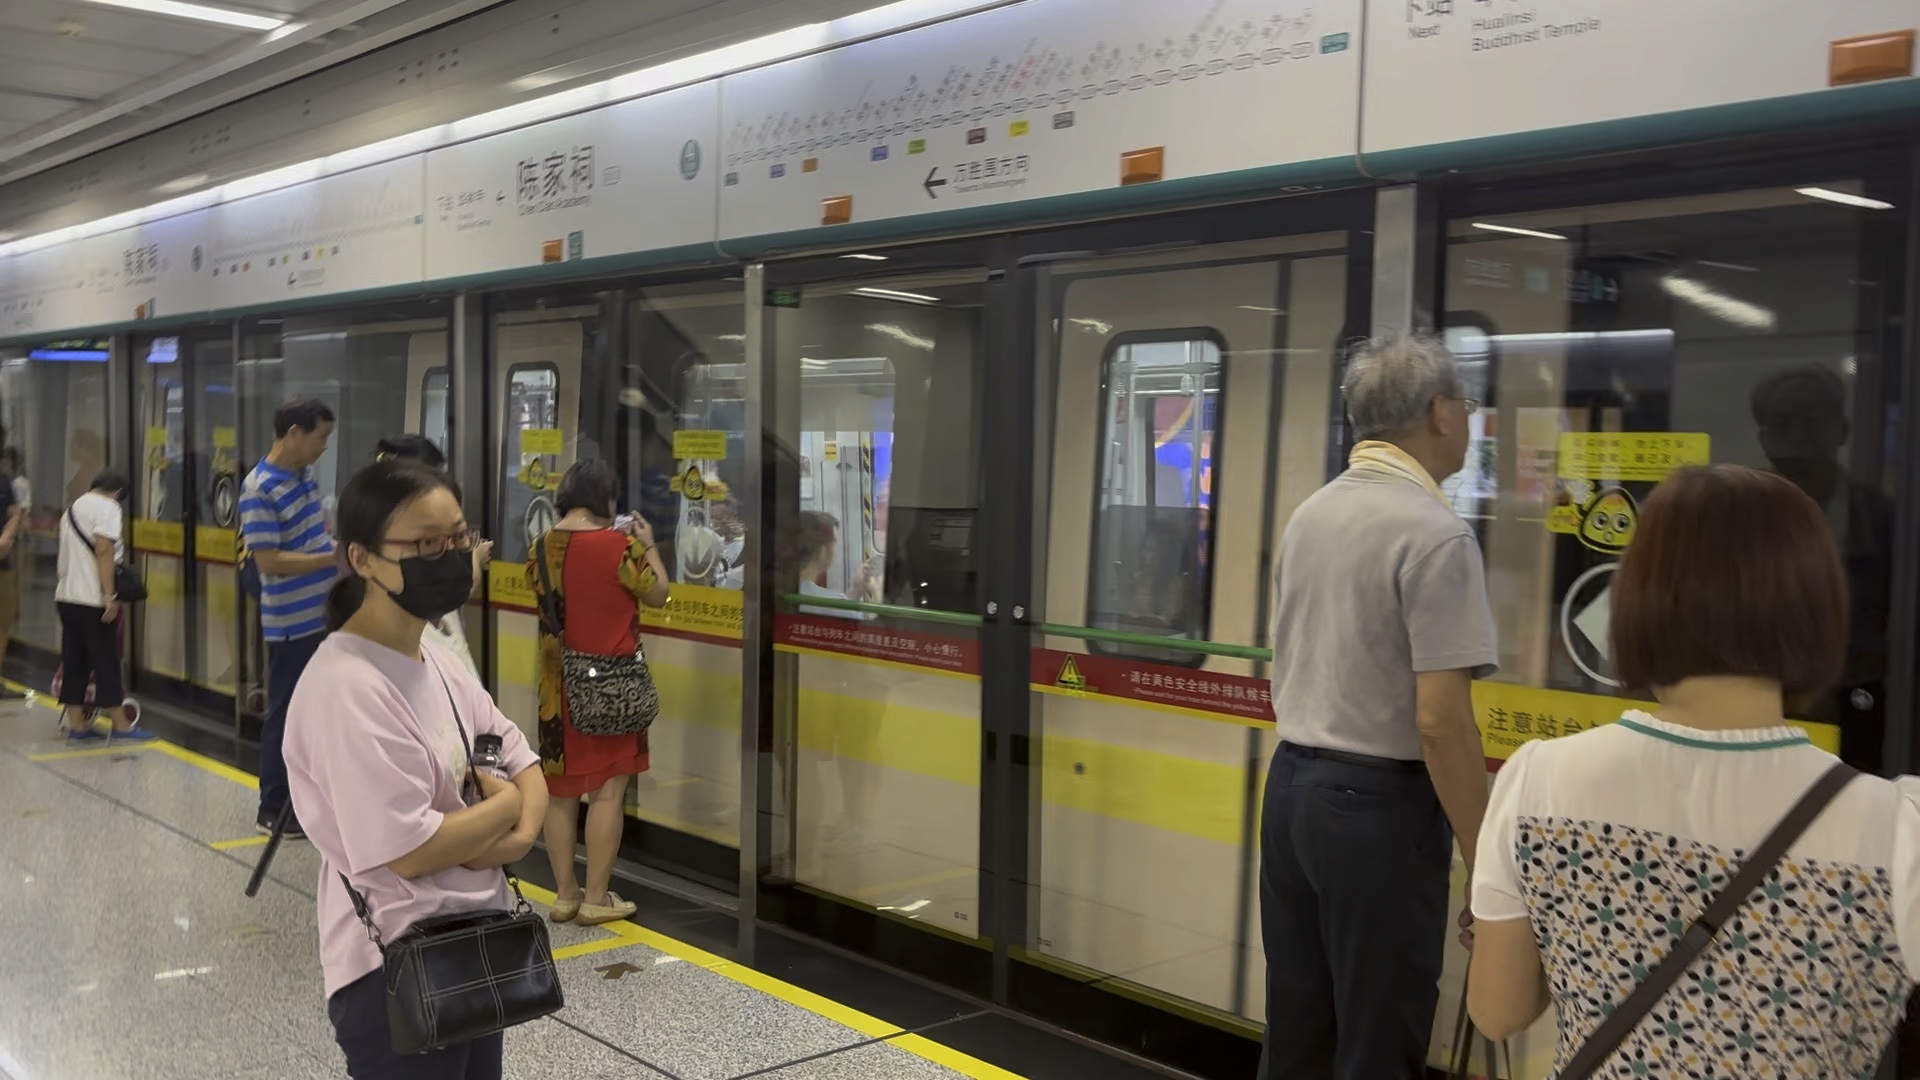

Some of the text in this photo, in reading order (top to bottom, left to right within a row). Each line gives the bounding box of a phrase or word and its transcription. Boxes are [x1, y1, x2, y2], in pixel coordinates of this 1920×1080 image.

[1408, 24, 1440, 40] Next
[1472, 10, 1537, 30] Hualinsi
[1472, 18, 1601, 51] Buddhist Temple
[517, 144, 594, 203] 陈家祠
[663, 598, 744, 622] 站台与列车之间的
